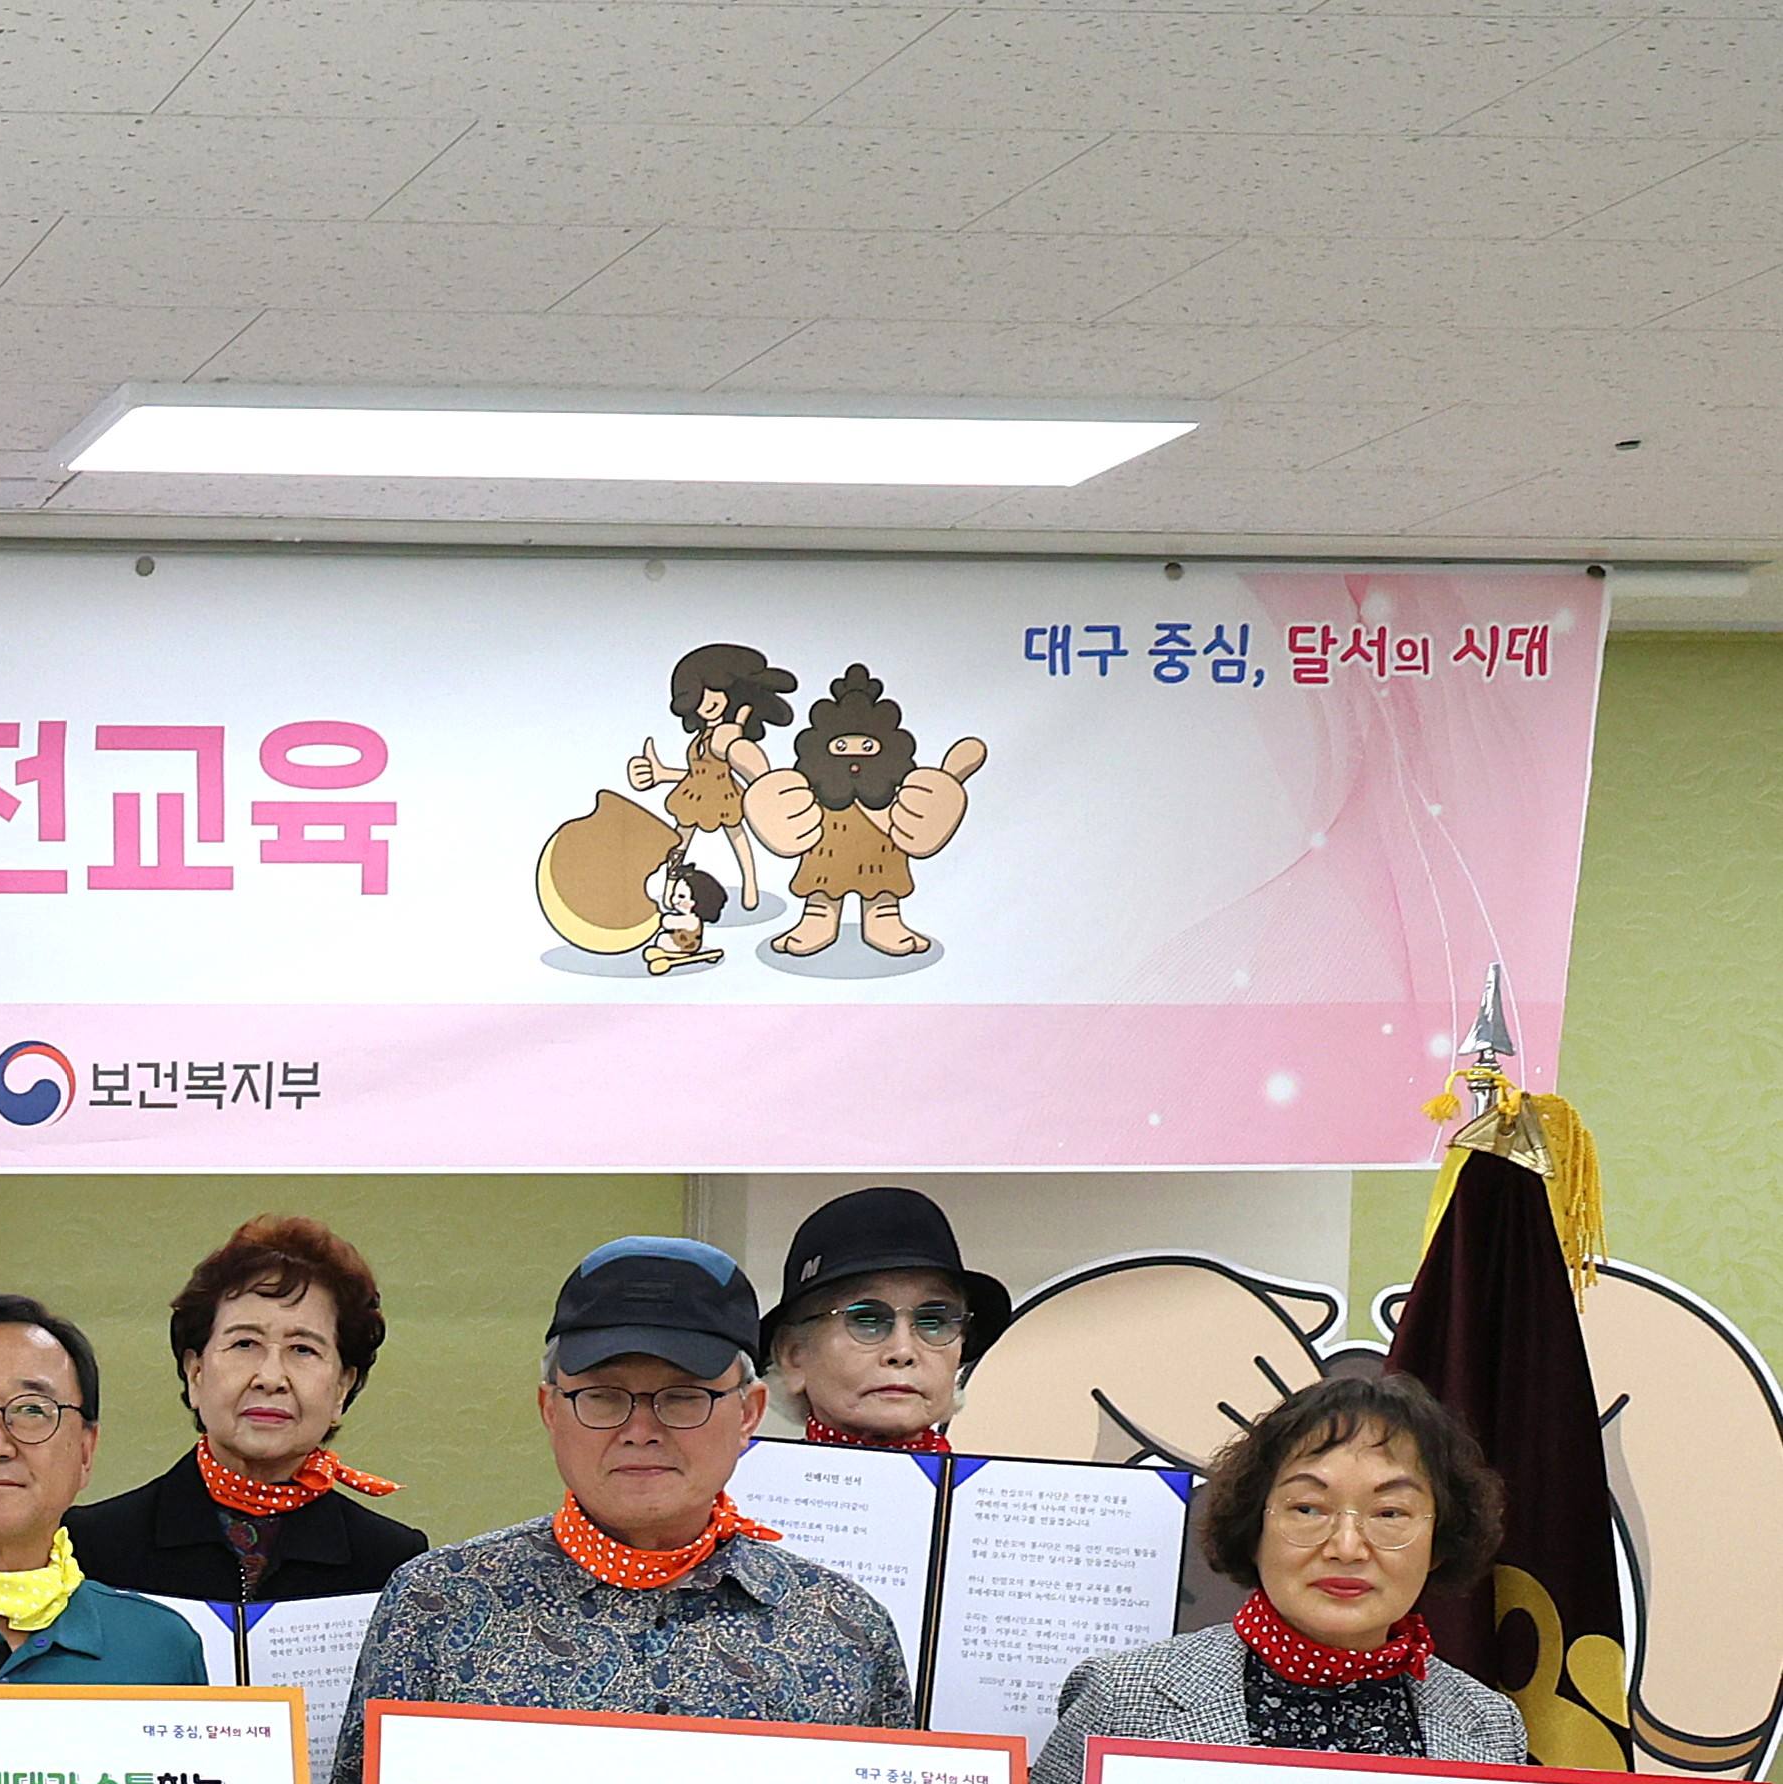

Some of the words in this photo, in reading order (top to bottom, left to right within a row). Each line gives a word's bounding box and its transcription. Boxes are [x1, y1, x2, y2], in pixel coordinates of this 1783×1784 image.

[1025, 625, 1128, 676] 대구
[1148, 624, 1264, 687] 중심,
[1289, 625, 1428, 684] 달서의
[1453, 625, 1548, 677] 시대
[89, 1061, 320, 1109] 보건복지부
[143, 1725, 167, 1736] 대구
[173, 1725, 202, 1739] 중심,
[206, 1726, 241, 1739] 달서의
[246, 1727, 270, 1737] 시대
[856, 1768, 881, 1780] 대구
[887, 1769, 916, 1784] 중심,
[921, 1772, 957, 1784] 달서의
